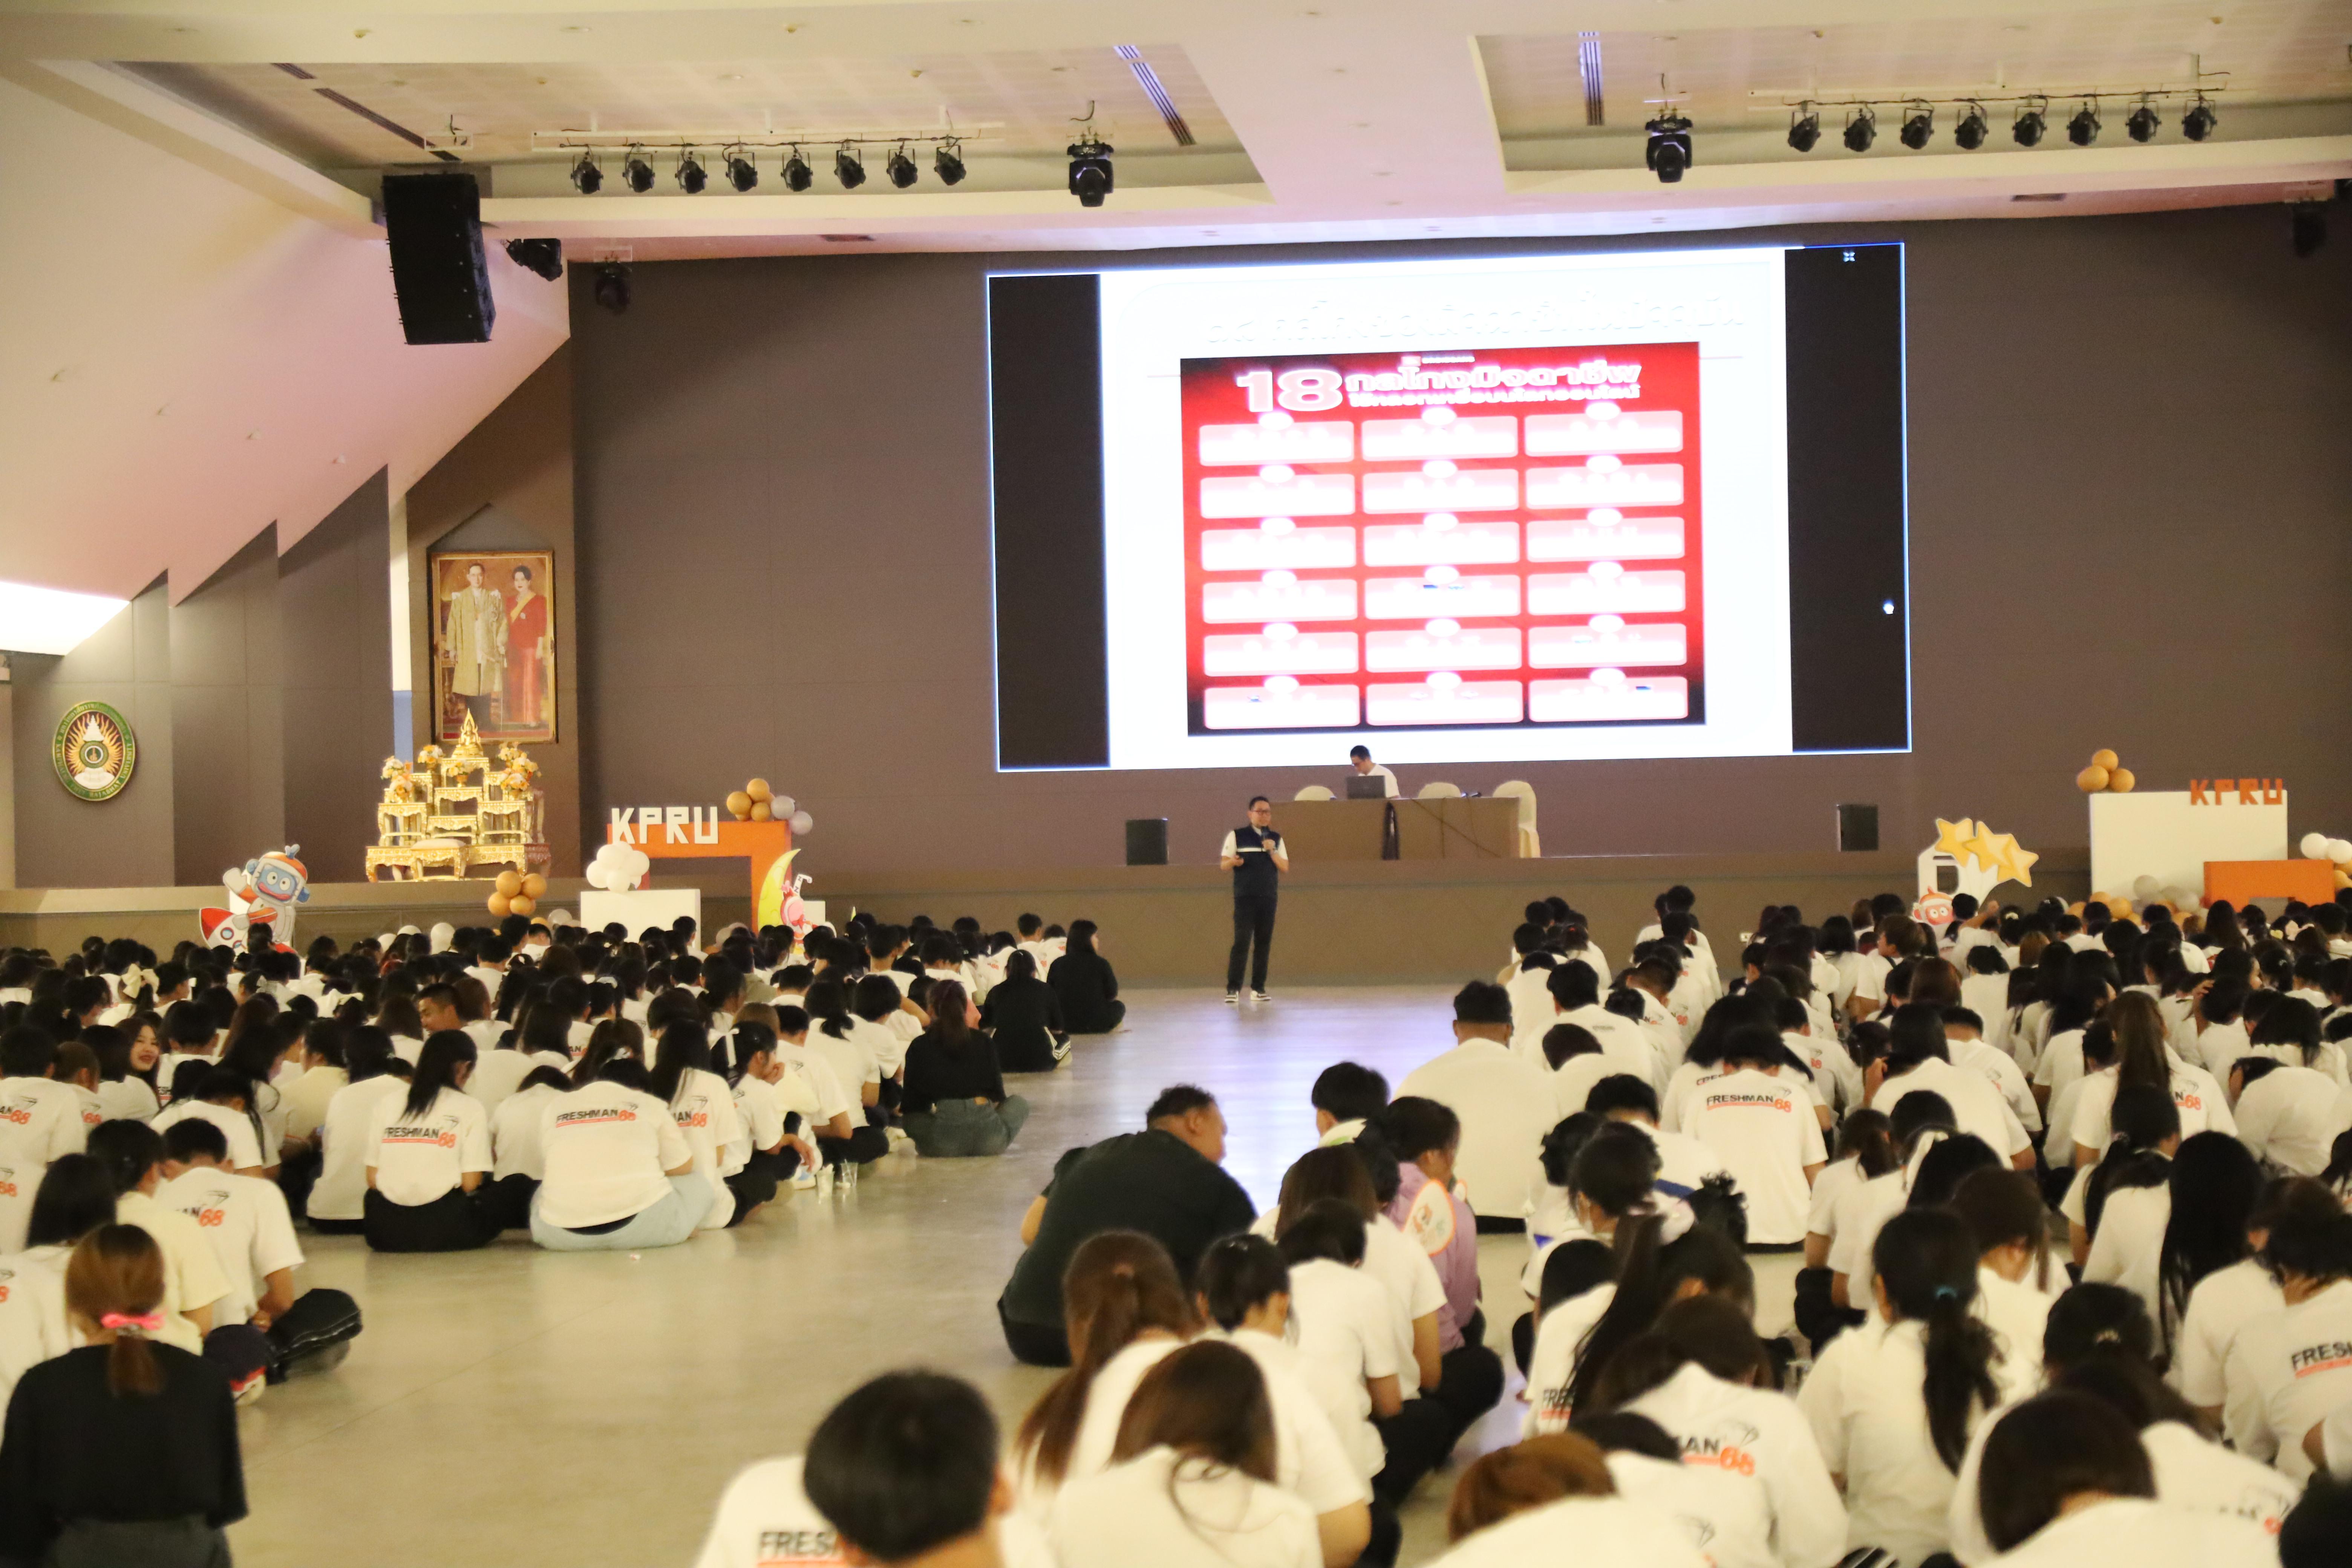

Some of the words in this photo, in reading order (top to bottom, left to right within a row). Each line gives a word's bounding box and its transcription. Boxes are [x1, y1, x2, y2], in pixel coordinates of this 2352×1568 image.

[1237, 369, 1343, 412] 18
[2190, 778, 2283, 805] KPRU
[611, 806, 718, 844] KPRU
[1707, 1095, 1774, 1106] FRESHMAN
[2185, 1094, 2202, 1110] 68
[556, 1109, 618, 1123] FRESHMAN
[757, 1531, 838, 1558] FRES
